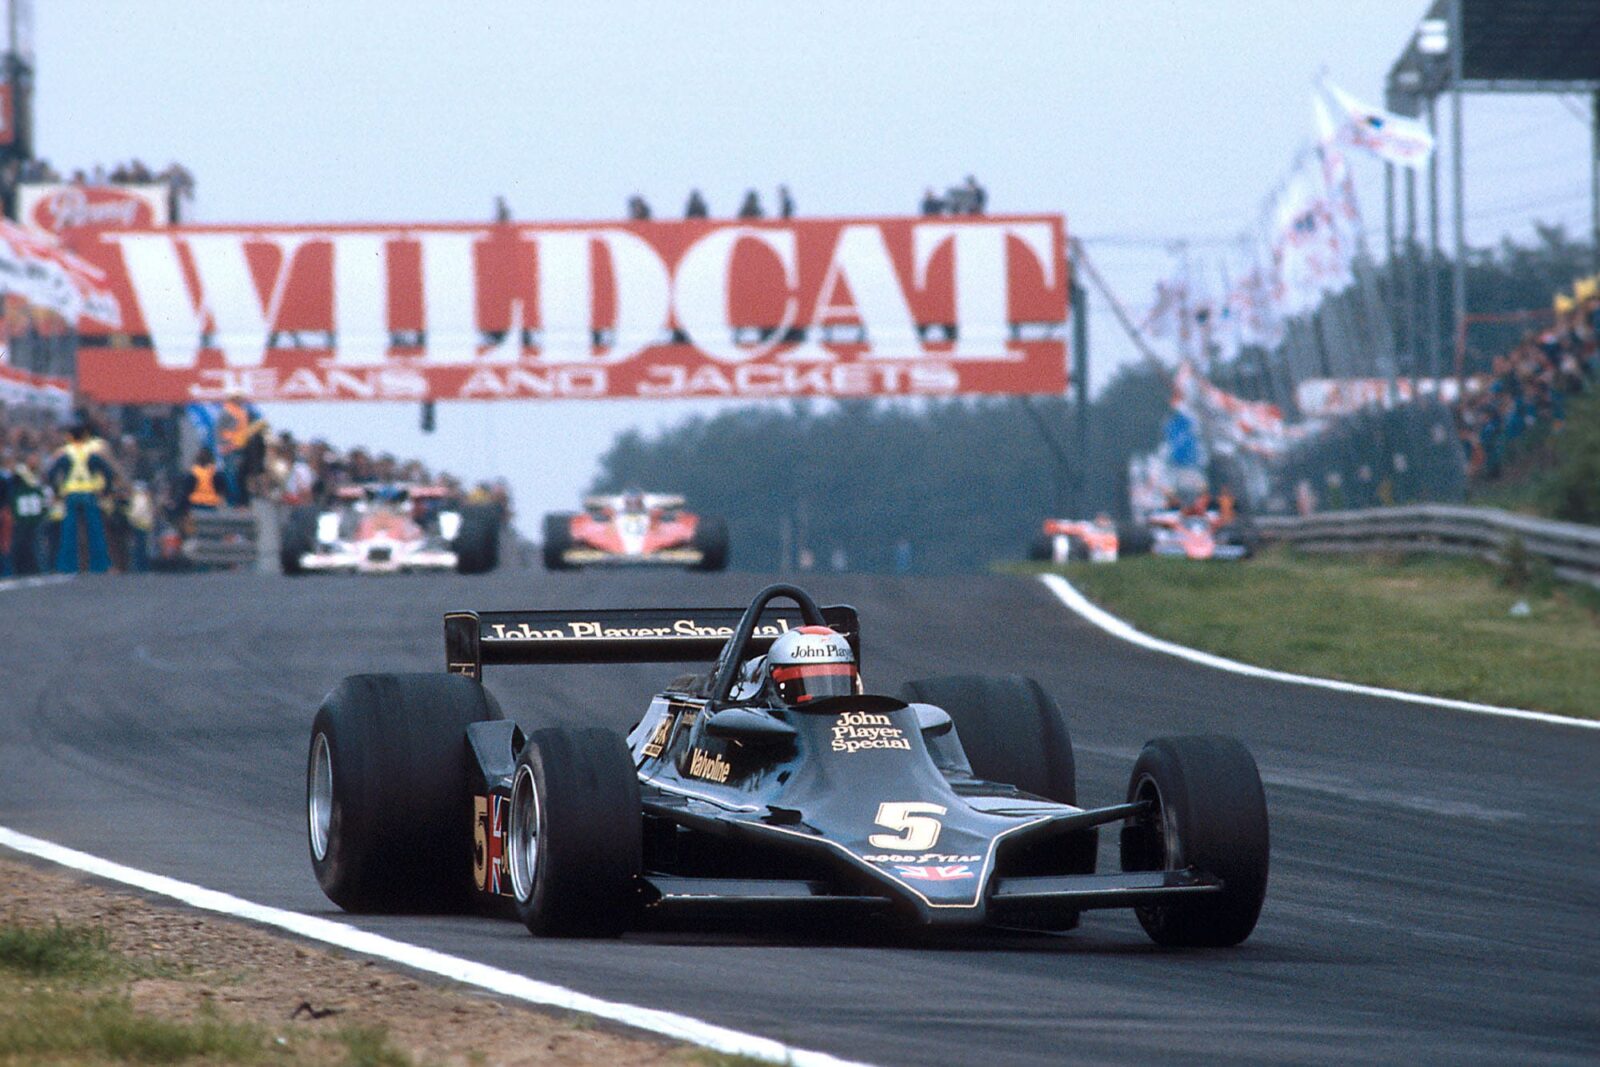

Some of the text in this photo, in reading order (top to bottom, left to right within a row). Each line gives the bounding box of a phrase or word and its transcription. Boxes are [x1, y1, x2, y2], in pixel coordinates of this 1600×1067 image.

[100, 223, 1057, 370] WILDCAT
[189, 363, 959, 400] JEANS AND JACKETS
[486, 623, 564, 639] John
[791, 645, 825, 659] John
[836, 711, 892, 727] John
[831, 726, 903, 740] Player
[831, 738, 911, 753] Special
[689, 747, 731, 783] Valvoline
[868, 801, 948, 851] 5
[474, 795, 488, 891] 5
